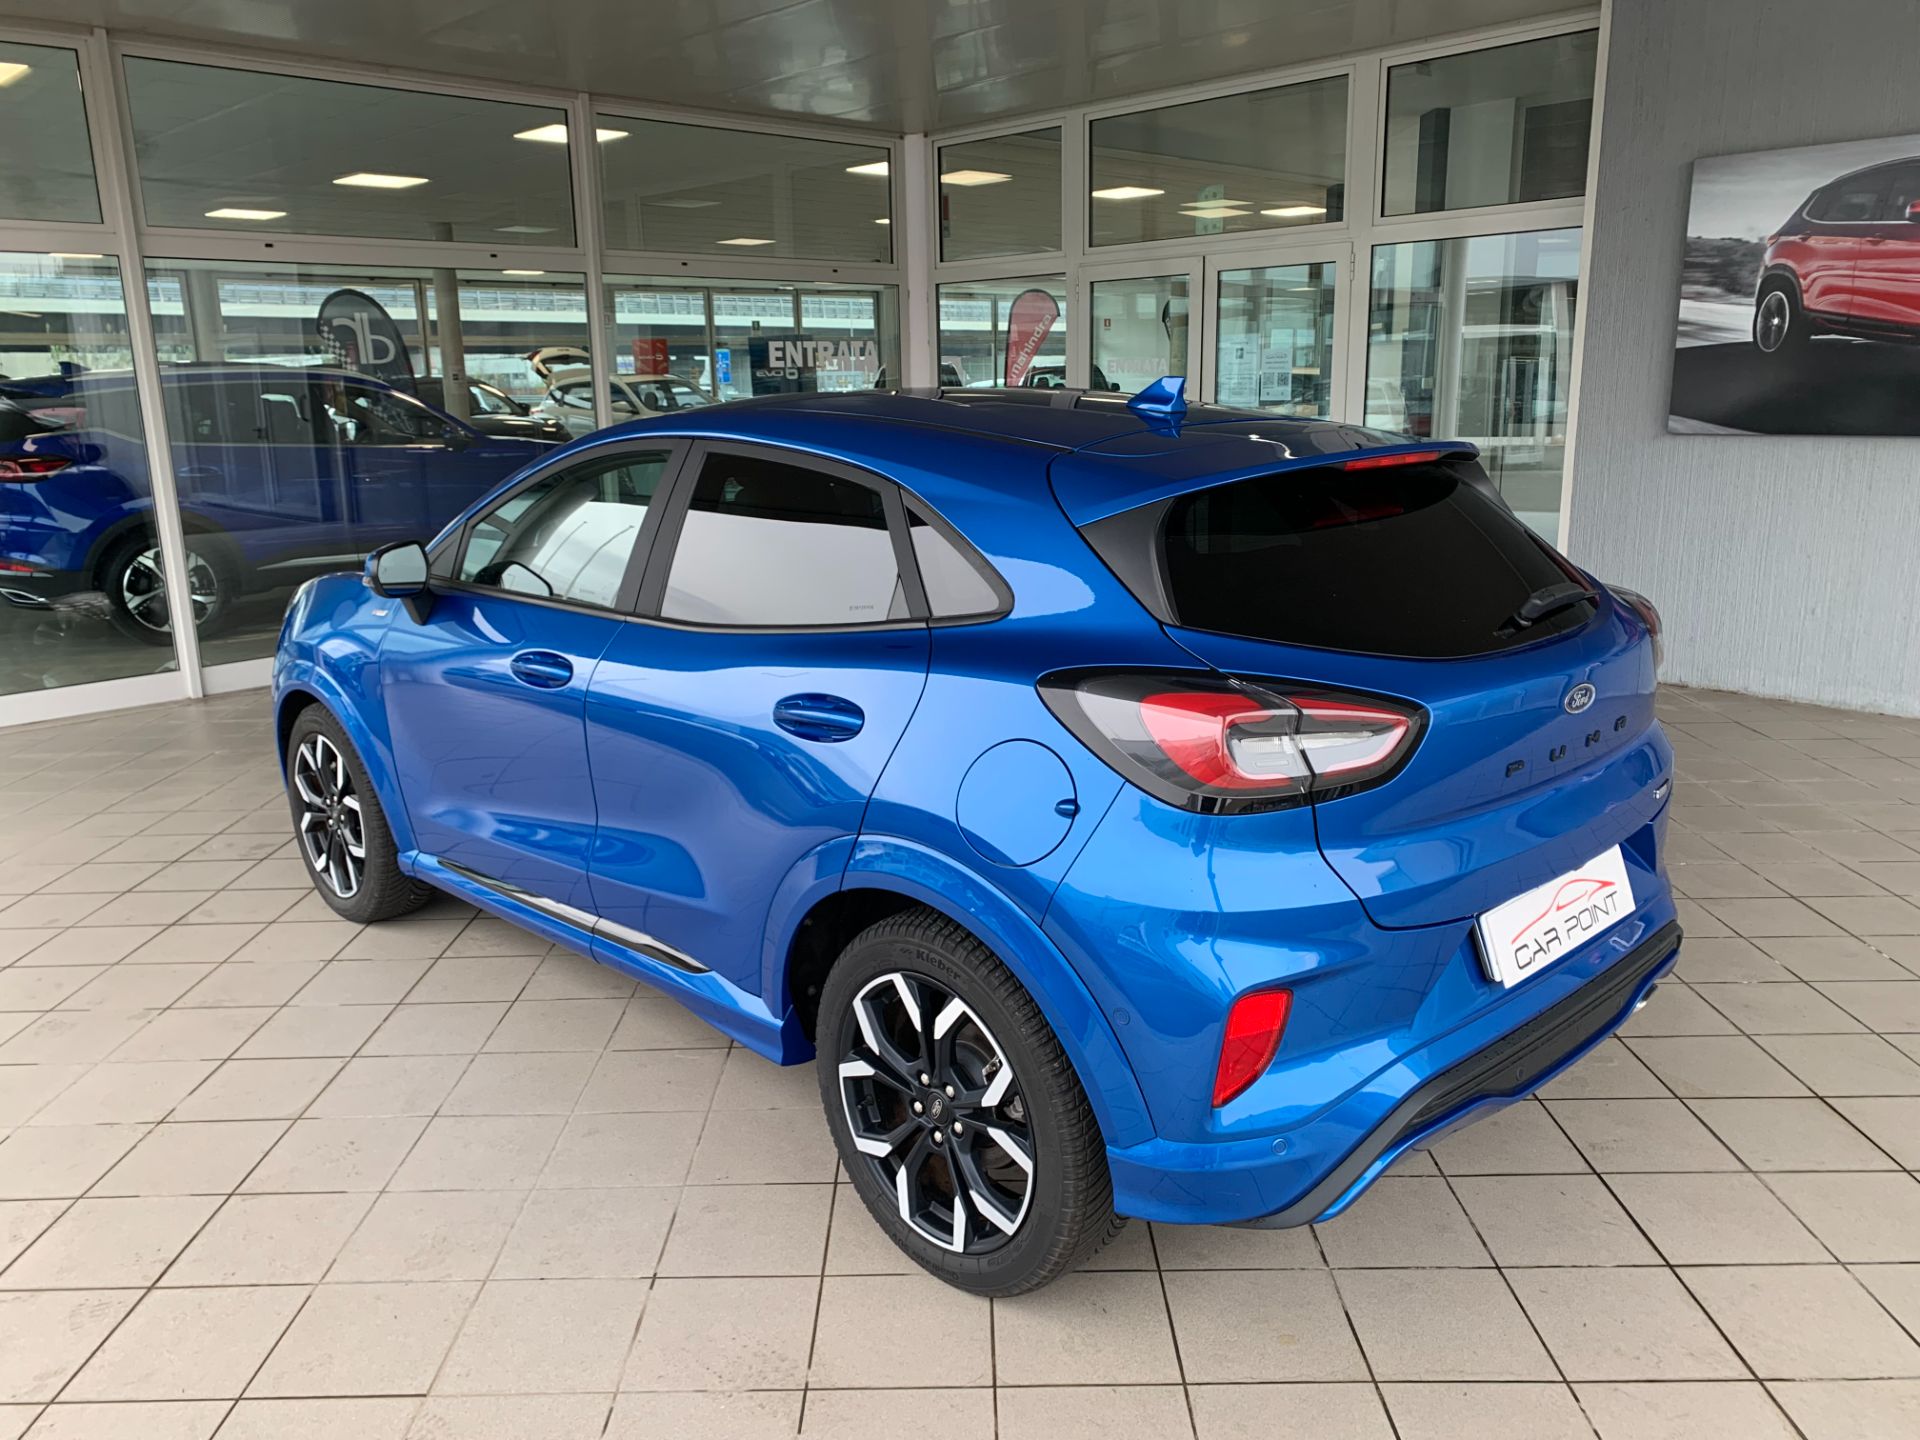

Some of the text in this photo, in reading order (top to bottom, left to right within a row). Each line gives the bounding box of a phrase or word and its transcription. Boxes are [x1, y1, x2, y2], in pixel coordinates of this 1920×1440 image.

[767, 341, 880, 372] ENTRATA
[1011, 313, 1053, 380] mahindra
[1505, 715, 1628, 778] PUMA
[1514, 890, 1618, 971] CAR POINT
[916, 949, 961, 980] Kleber
